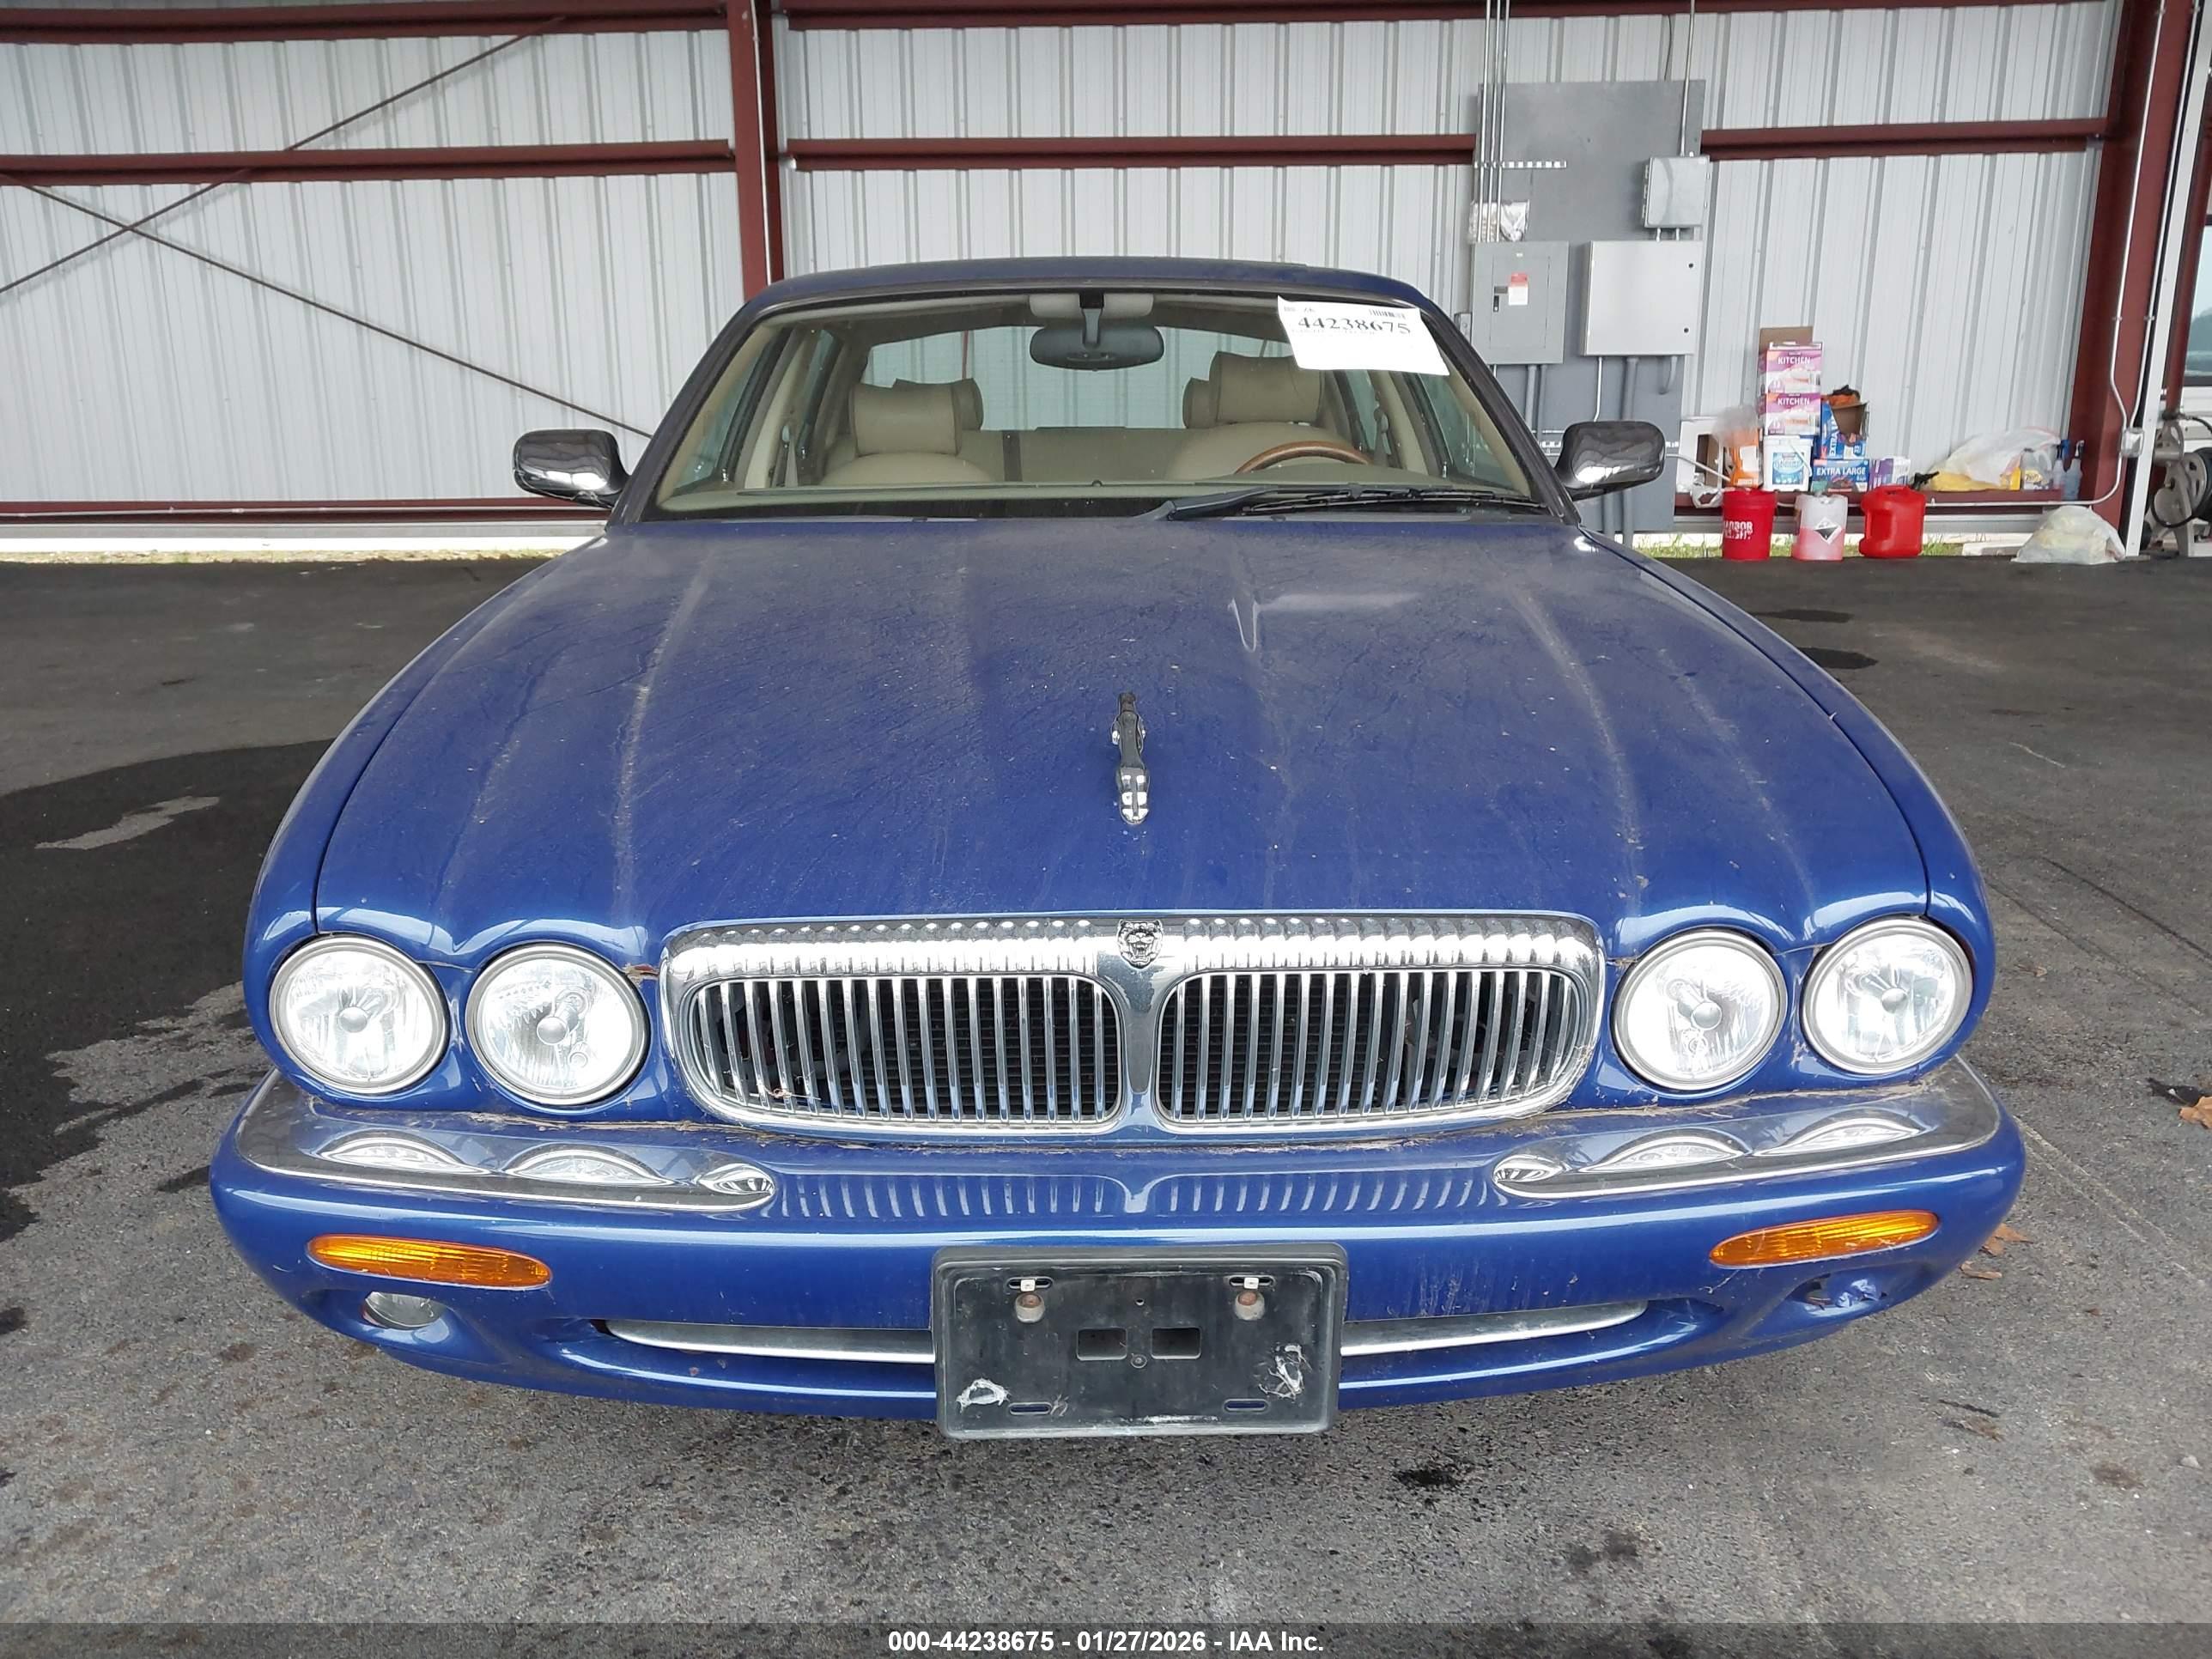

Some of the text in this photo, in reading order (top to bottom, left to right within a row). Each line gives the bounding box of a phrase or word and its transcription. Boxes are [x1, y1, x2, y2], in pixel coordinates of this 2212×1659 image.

[1298, 316, 1411, 334] 44238675
[1778, 356, 1810, 365] KITCHEN
[1778, 398, 1810, 406] KITCHEN
[1816, 467, 1841, 476] EXTRA
[1843, 466, 1866, 476] LARGE
